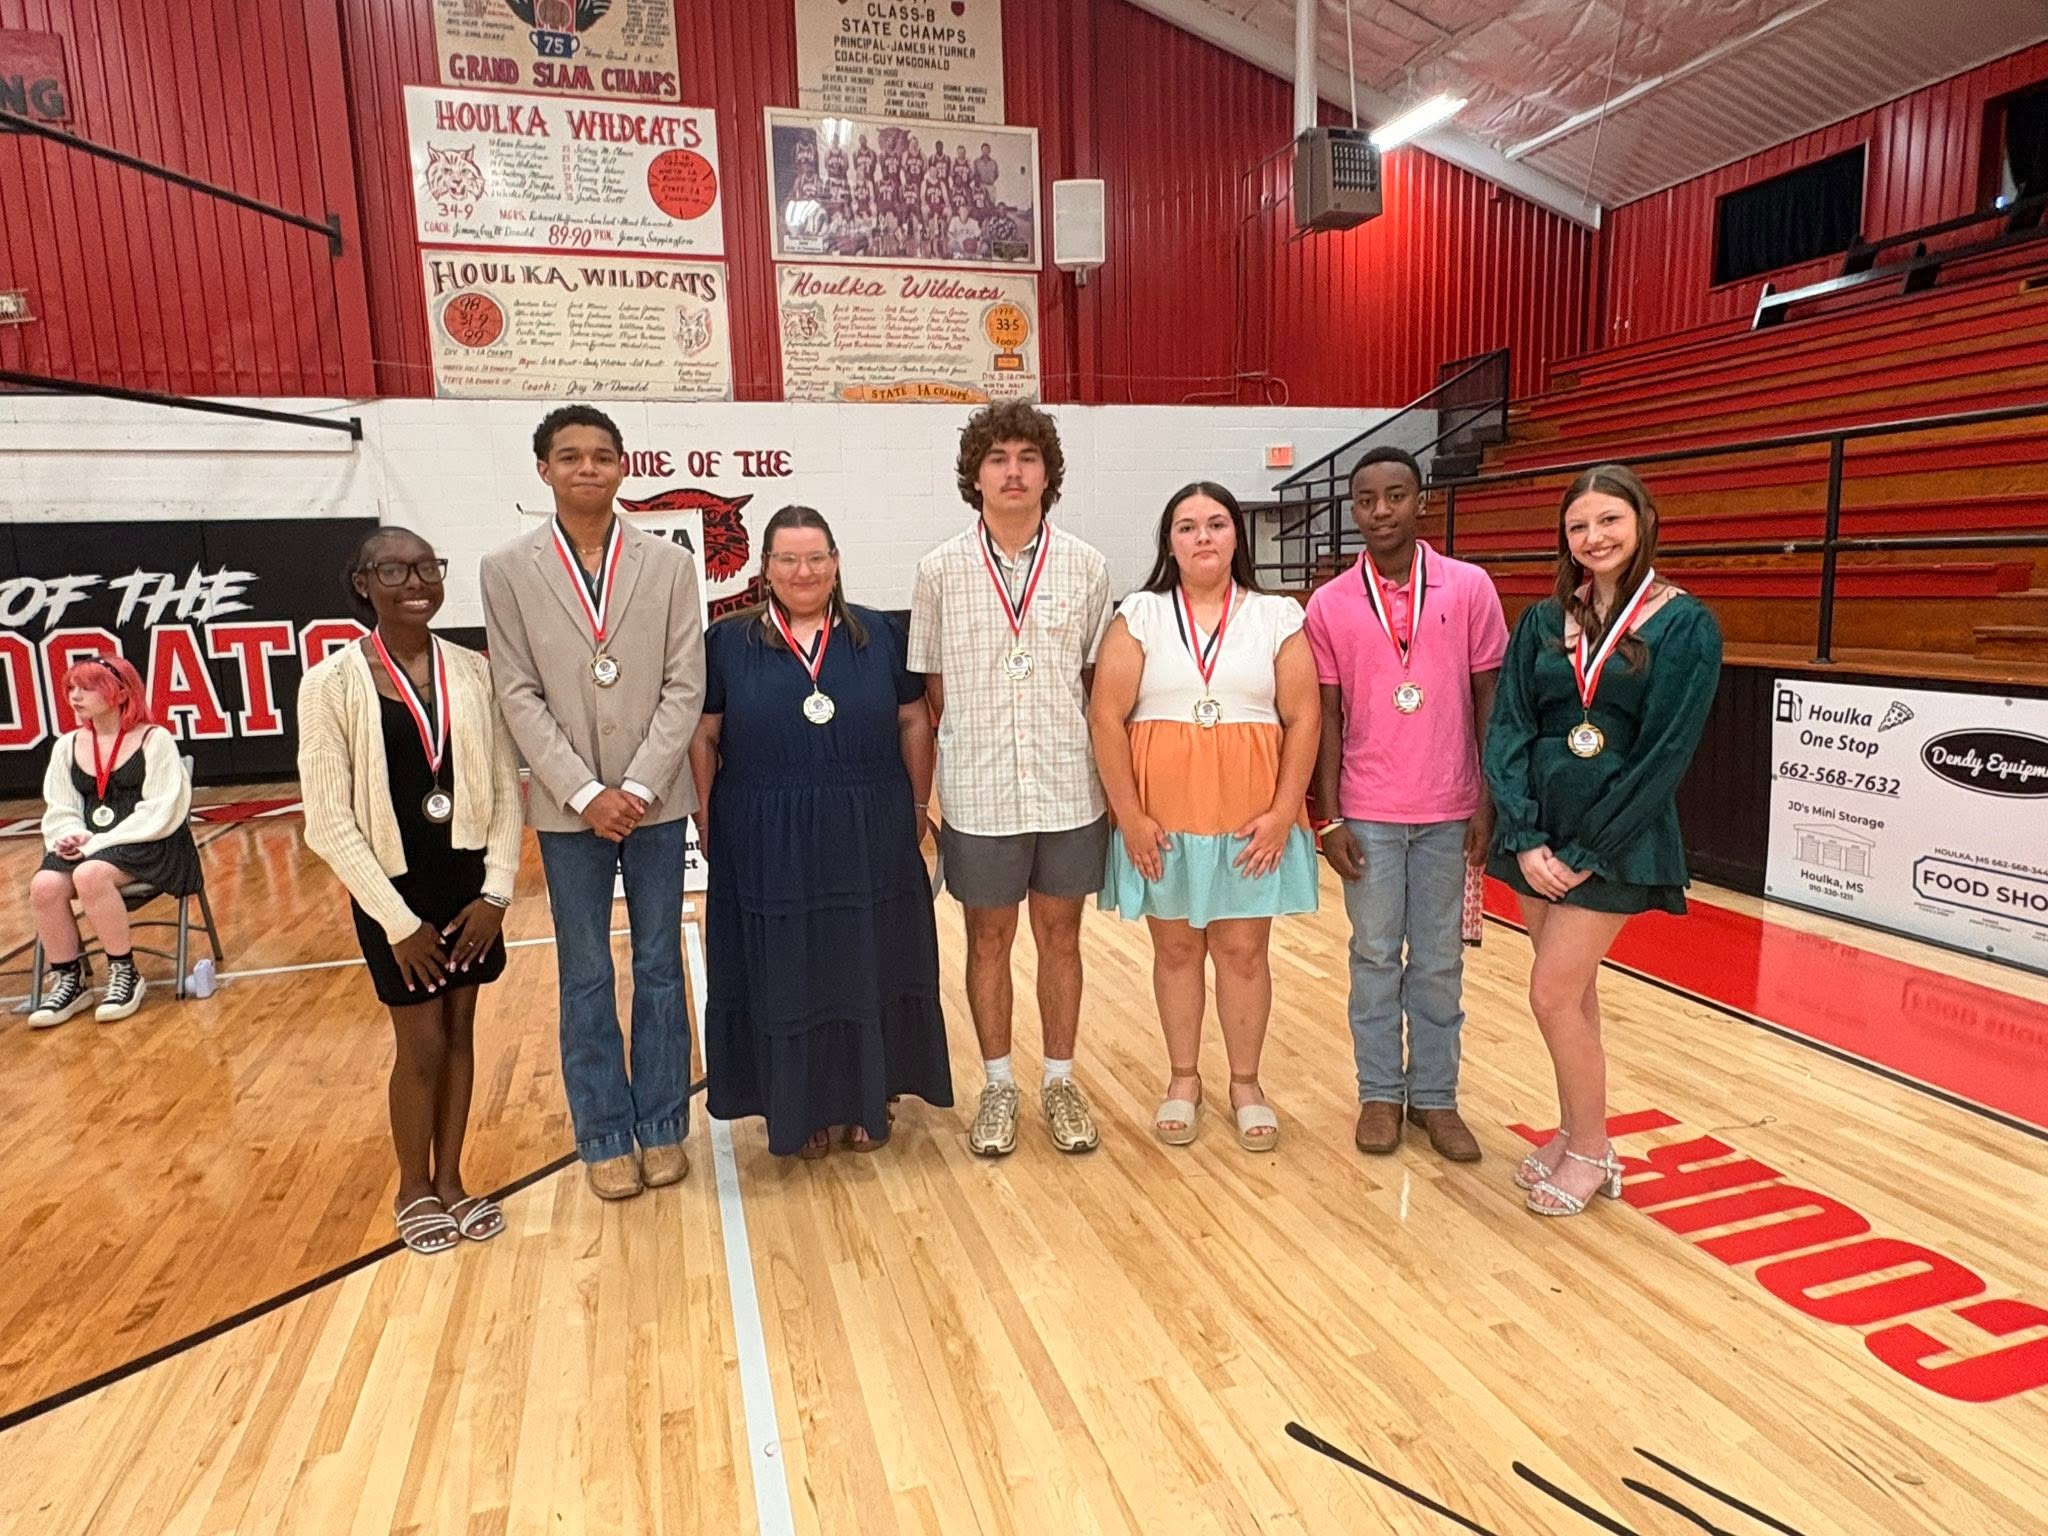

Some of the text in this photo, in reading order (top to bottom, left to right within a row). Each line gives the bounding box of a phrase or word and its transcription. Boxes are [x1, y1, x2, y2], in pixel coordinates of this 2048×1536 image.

[867, 3, 935, 23] CLASS-B
[842, 18, 966, 44] STATE CHAMPS
[544, 36, 564, 54] 75
[939, 46, 976, 59] TURNER
[450, 53, 676, 97] GRAND SLAM CHAMPS
[435, 100, 702, 148] HOULKA WILDCATS
[438, 203, 474, 220] 34-9
[548, 224, 592, 247] 89-90
[429, 261, 717, 303] HOULKA WILDCATS
[787, 270, 1005, 300] Houlka Wildcats
[460, 297, 481, 311] 98
[871, 387, 907, 399] STATE
[687, 450, 722, 478] OF
[733, 450, 794, 478] THE
[0, 560, 261, 632] OF THE
[1808, 704, 1873, 727] Houlka
[1800, 730, 1879, 759] One Stop
[1931, 746, 1984, 777] Dendy
[1779, 761, 1901, 796] 662-568-7632
[1788, 800, 1885, 830] JD's Mini Storage
[1934, 847, 1974, 863] HOULKA,
[1976, 855, 1990, 865] MS
[1800, 868, 1864, 893] Houlka, MS
[1923, 870, 2048, 911] FOOD SHO
